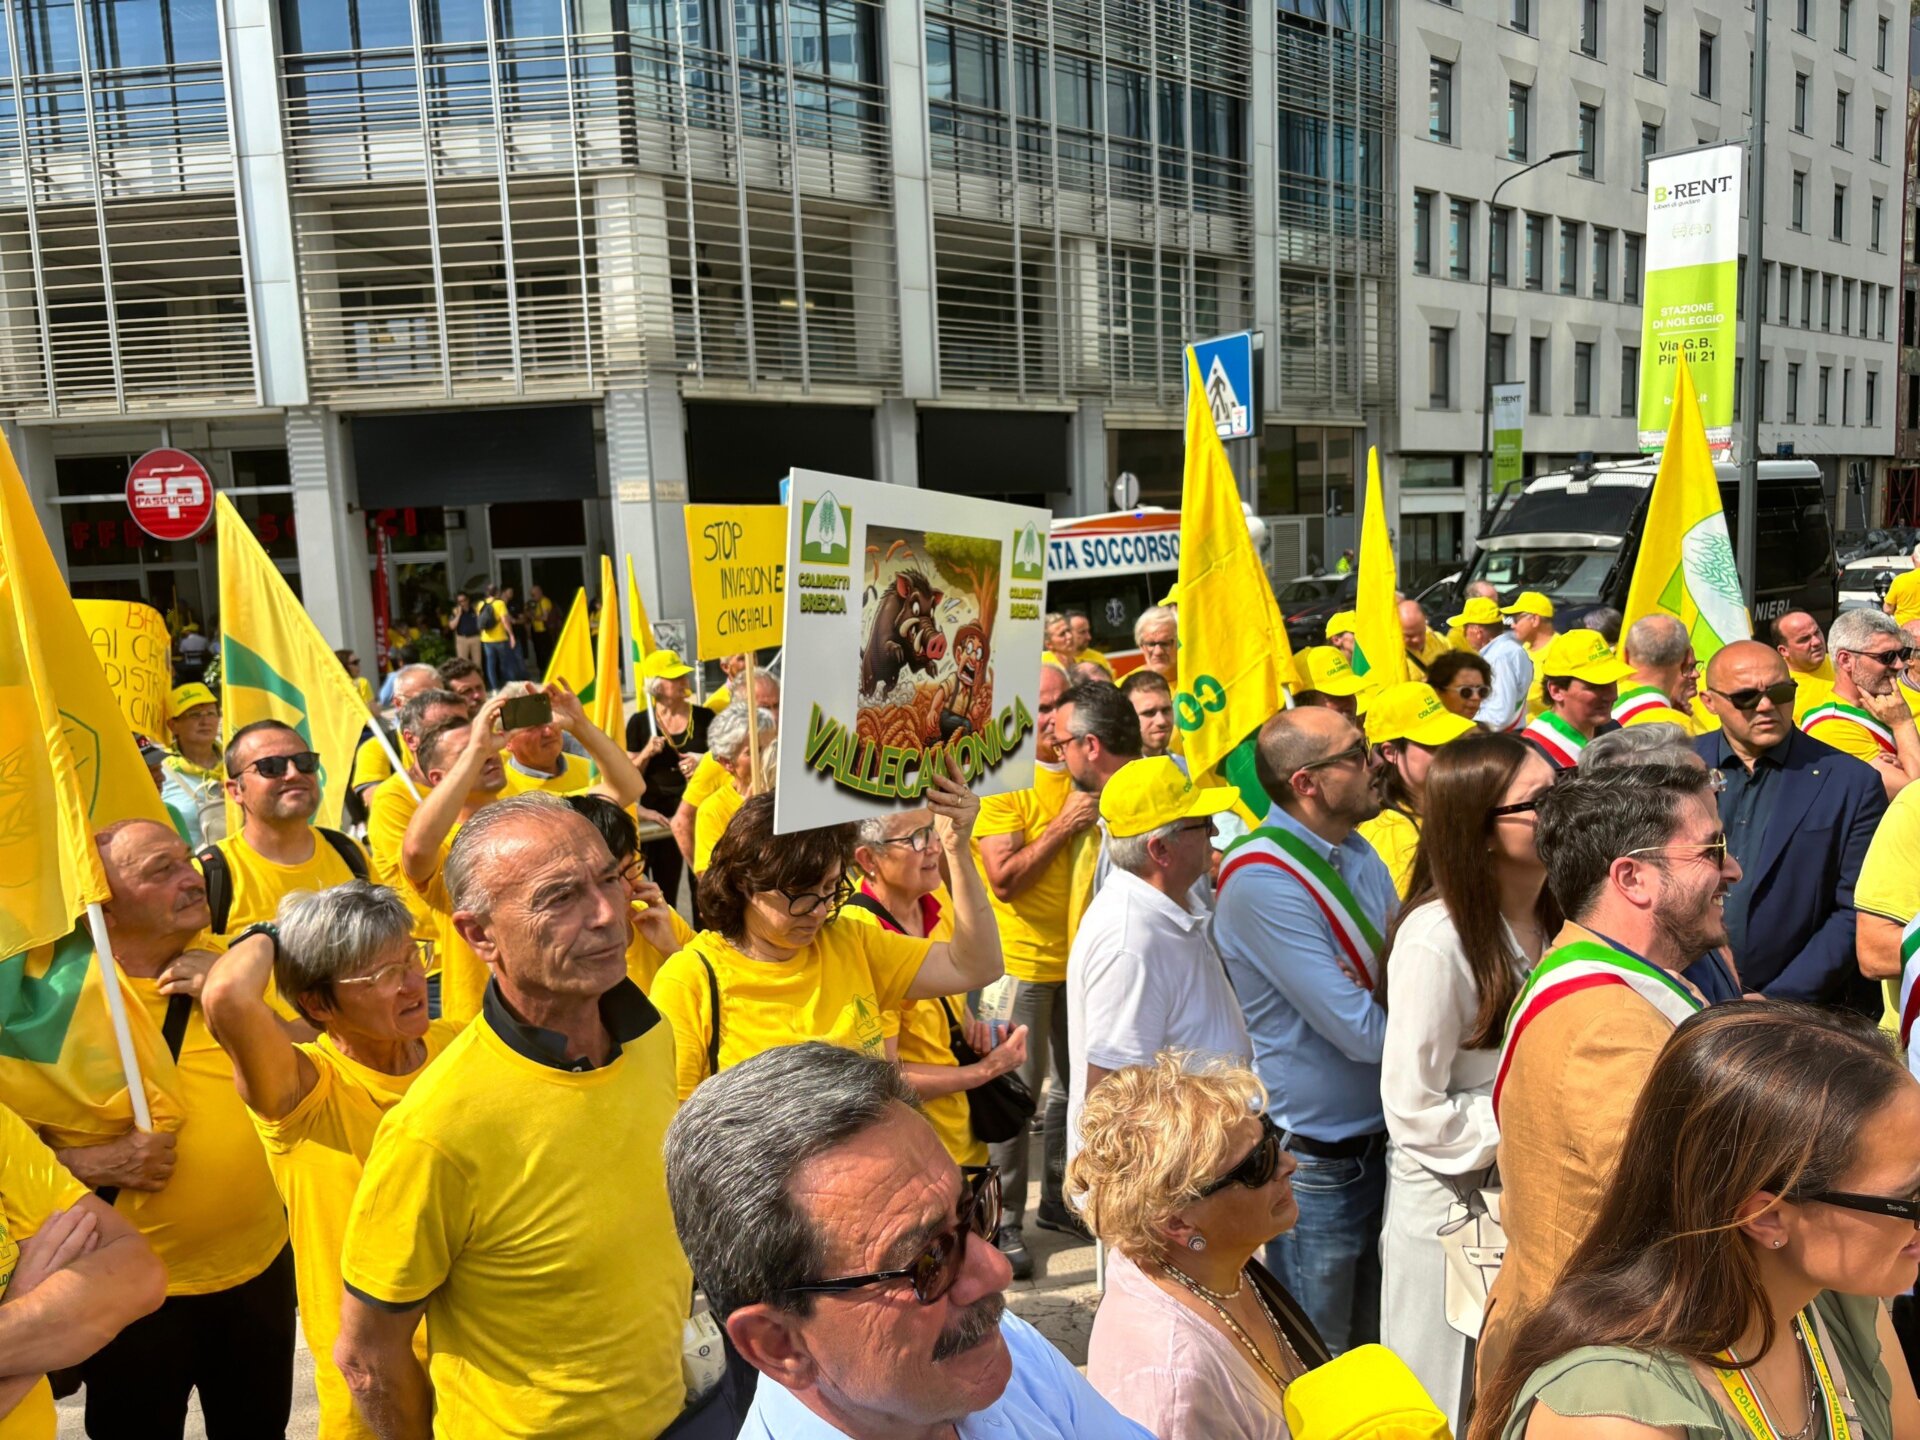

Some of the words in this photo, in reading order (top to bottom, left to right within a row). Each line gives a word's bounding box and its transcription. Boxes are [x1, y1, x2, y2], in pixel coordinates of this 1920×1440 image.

[1660, 303, 1714, 317] STAZIONE
[1652, 320, 1664, 329] DI
[1666, 314, 1725, 328] NOLEGGIO
[1659, 340, 1679, 352] Via
[1683, 337, 1712, 350] G.B.
[1659, 351, 1696, 365] Pirlli
[1700, 351, 1715, 362] 21
[136, 494, 195, 508] PASCUCCI
[703, 521, 743, 562] STOP
[1082, 533, 1179, 568] SOCCORSO
[720, 564, 784, 600] INVASIONE
[800, 593, 847, 614] BRESCIA
[1010, 603, 1039, 620] BRESCIA
